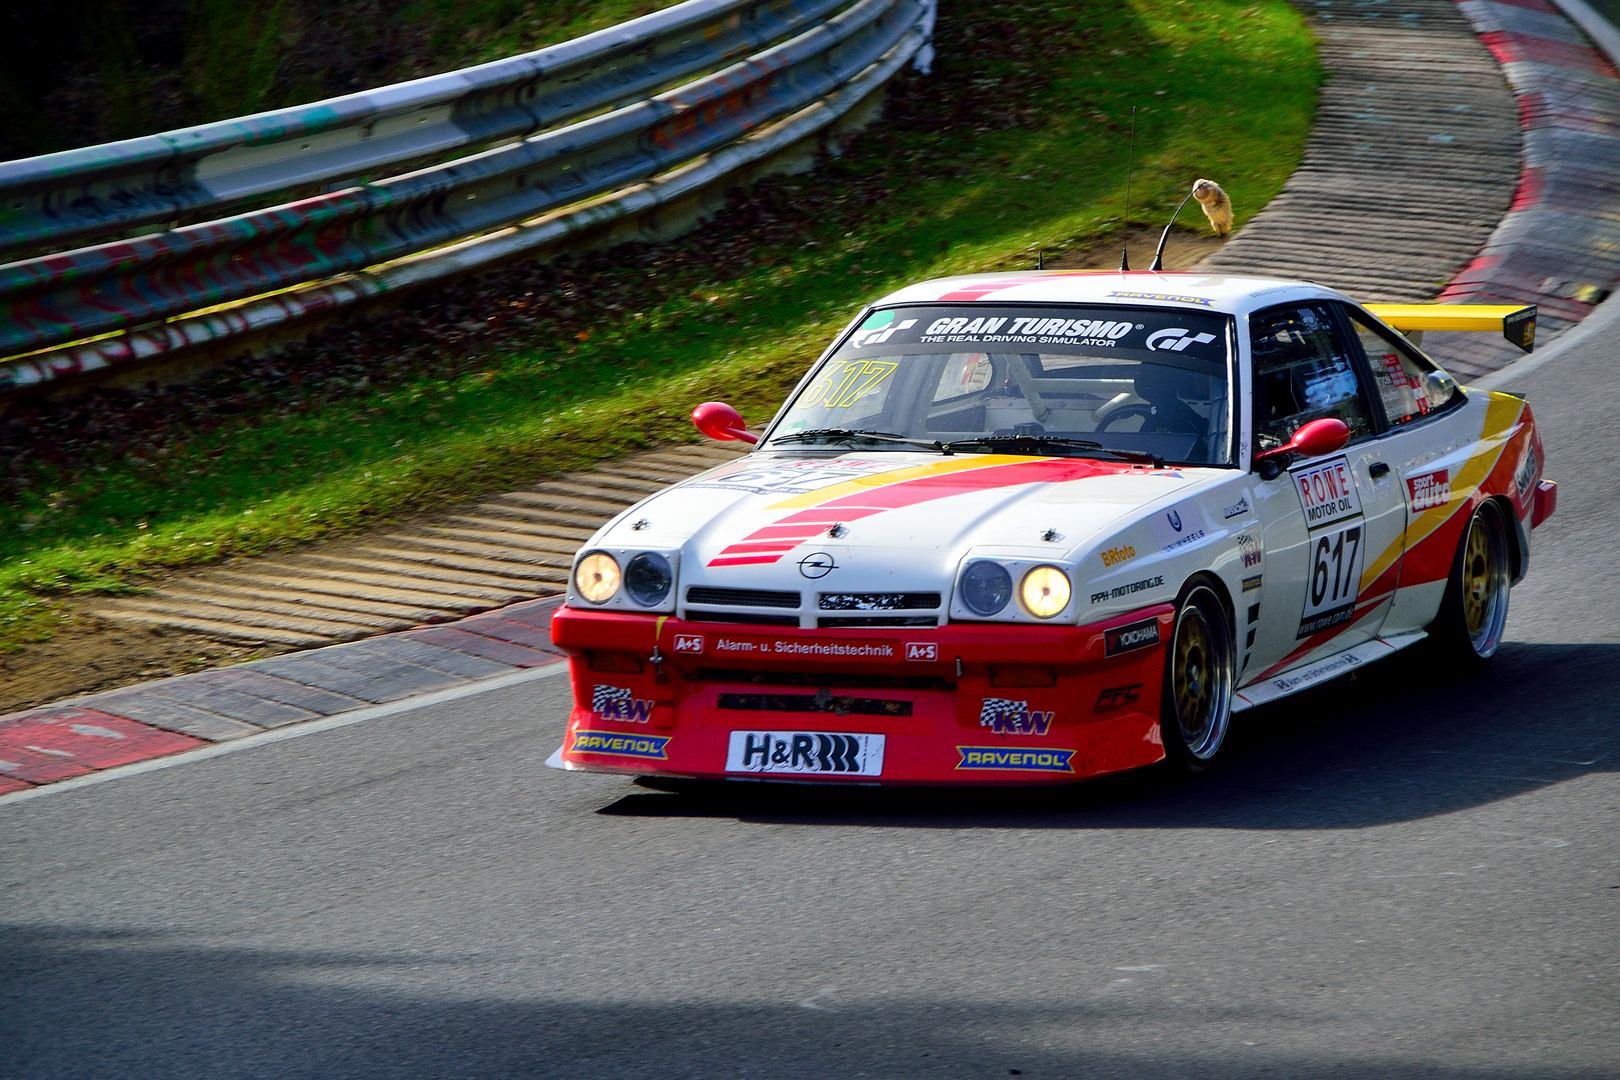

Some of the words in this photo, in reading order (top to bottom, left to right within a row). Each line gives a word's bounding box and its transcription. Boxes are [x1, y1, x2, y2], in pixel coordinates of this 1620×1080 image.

[925, 317, 1008, 335] GRAN
[982, 335, 1036, 343] DRIVING
[1039, 336, 1116, 348] SIMULATOR
[797, 360, 898, 410] 617
[1299, 466, 1350, 508] ROWE
[1413, 474, 1434, 491] sport
[1413, 482, 1452, 510] auto
[1308, 502, 1338, 521] MOTOR
[1338, 498, 1353, 512] OIL
[1101, 544, 1136, 568] BRfoto
[1312, 526, 1361, 607] 617
[675, 637, 702, 651] A+S
[1119, 625, 1159, 647] YOKOHAMA
[716, 639, 758, 652] Alarm-
[760, 642, 771, 653] u.
[774, 641, 894, 657] Sicherheitstechnik
[909, 645, 936, 659] A+S
[600, 698, 655, 724] KW
[991, 711, 1055, 735] KW
[577, 736, 661, 754] RAVENOL
[742, 733, 820, 772] H&R
[967, 751, 1065, 767] RAVENOL
